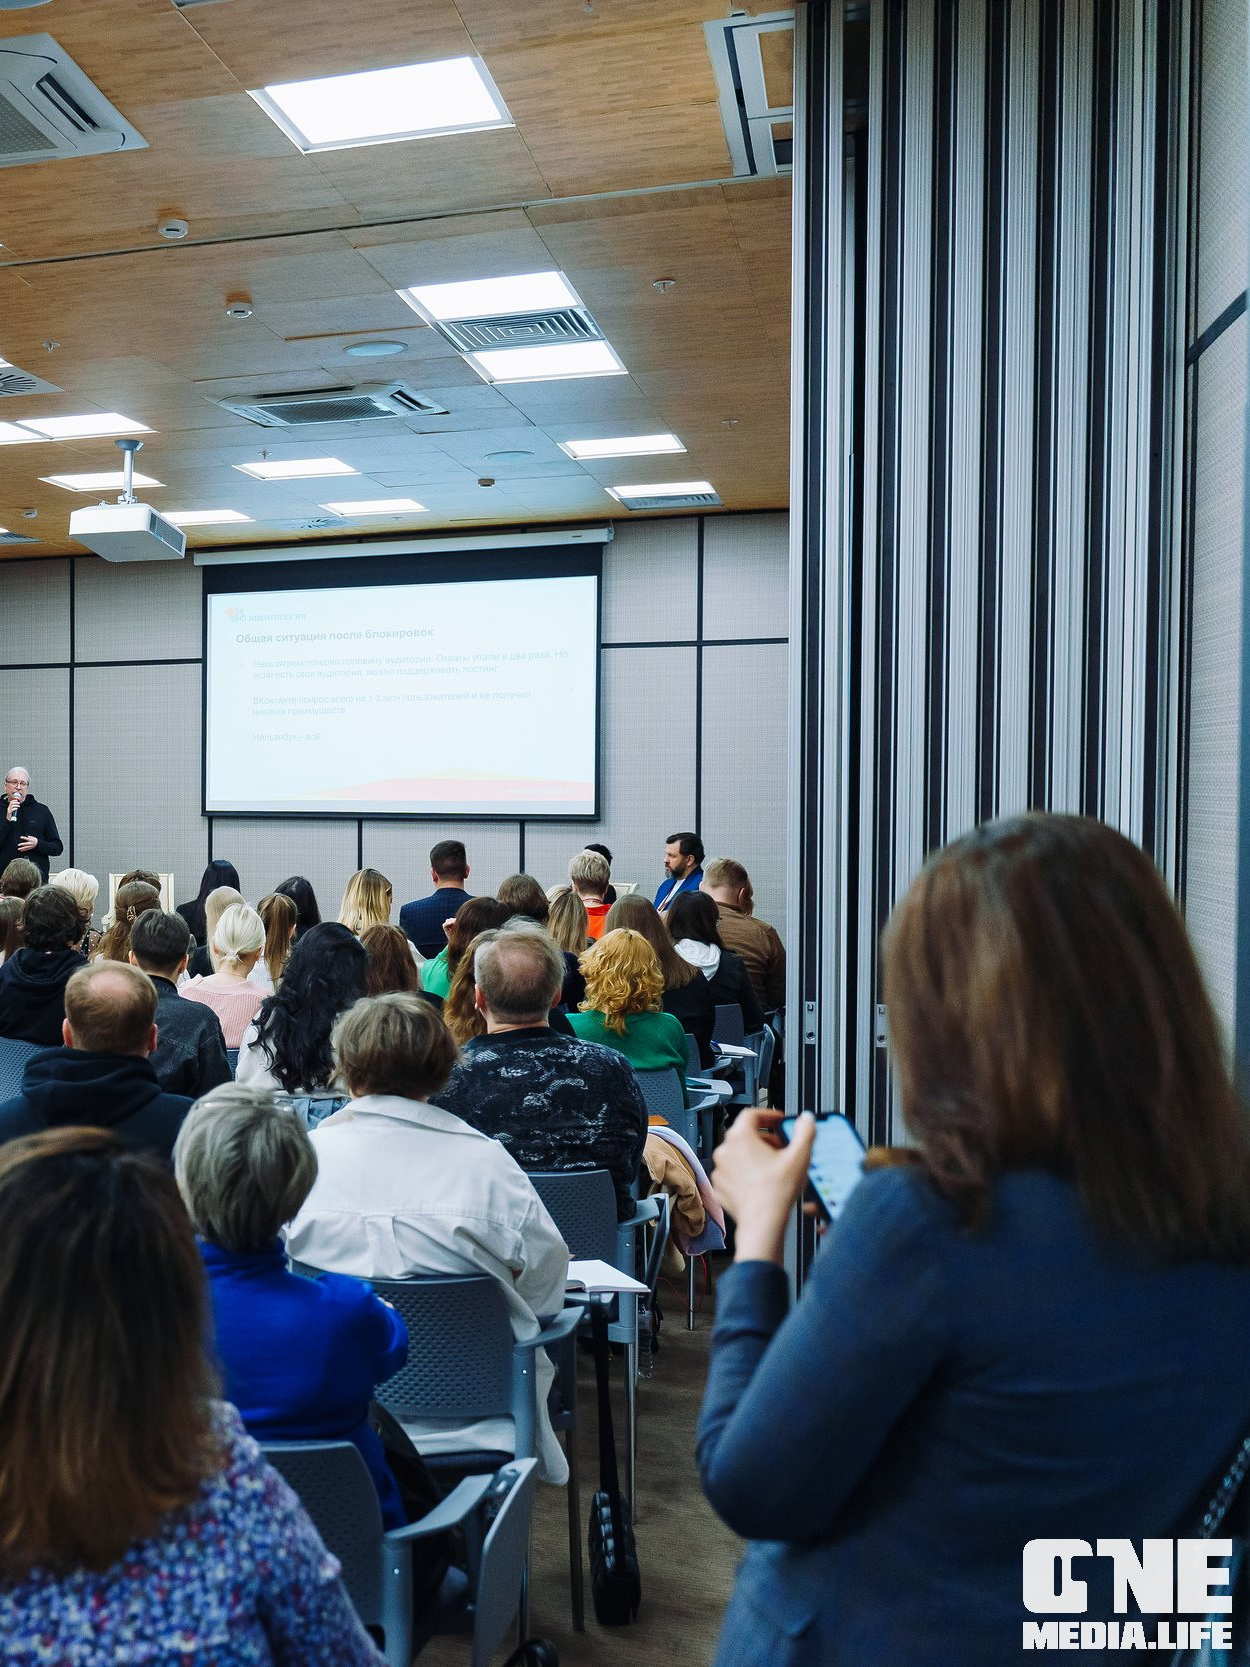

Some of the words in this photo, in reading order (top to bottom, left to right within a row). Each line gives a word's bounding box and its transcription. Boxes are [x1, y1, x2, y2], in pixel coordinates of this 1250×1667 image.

[236, 633, 273, 645] Общая
[275, 632, 327, 644] ситуация
[329, 631, 363, 641] после
[365, 627, 434, 640] блокировок
[341, 656, 383, 668] половину
[435, 653, 471, 663] Охваты
[472, 653, 499, 663] упали
[509, 651, 526, 661] два
[555, 649, 568, 659] Но
[275, 671, 294, 679] есть
[295, 670, 315, 678] своя
[365, 668, 395, 677] можно
[396, 666, 461, 677] поддерживать
[463, 664, 499, 674] постинг
[253, 696, 298, 705] ВКонтакте
[330, 695, 355, 704] всего
[355, 695, 367, 703] на
[382, 694, 400, 703] млн
[402, 691, 470, 702] пользователей
[479, 692, 491, 700] не
[492, 690, 532, 701] получил
[287, 705, 346, 717] преимуществ
